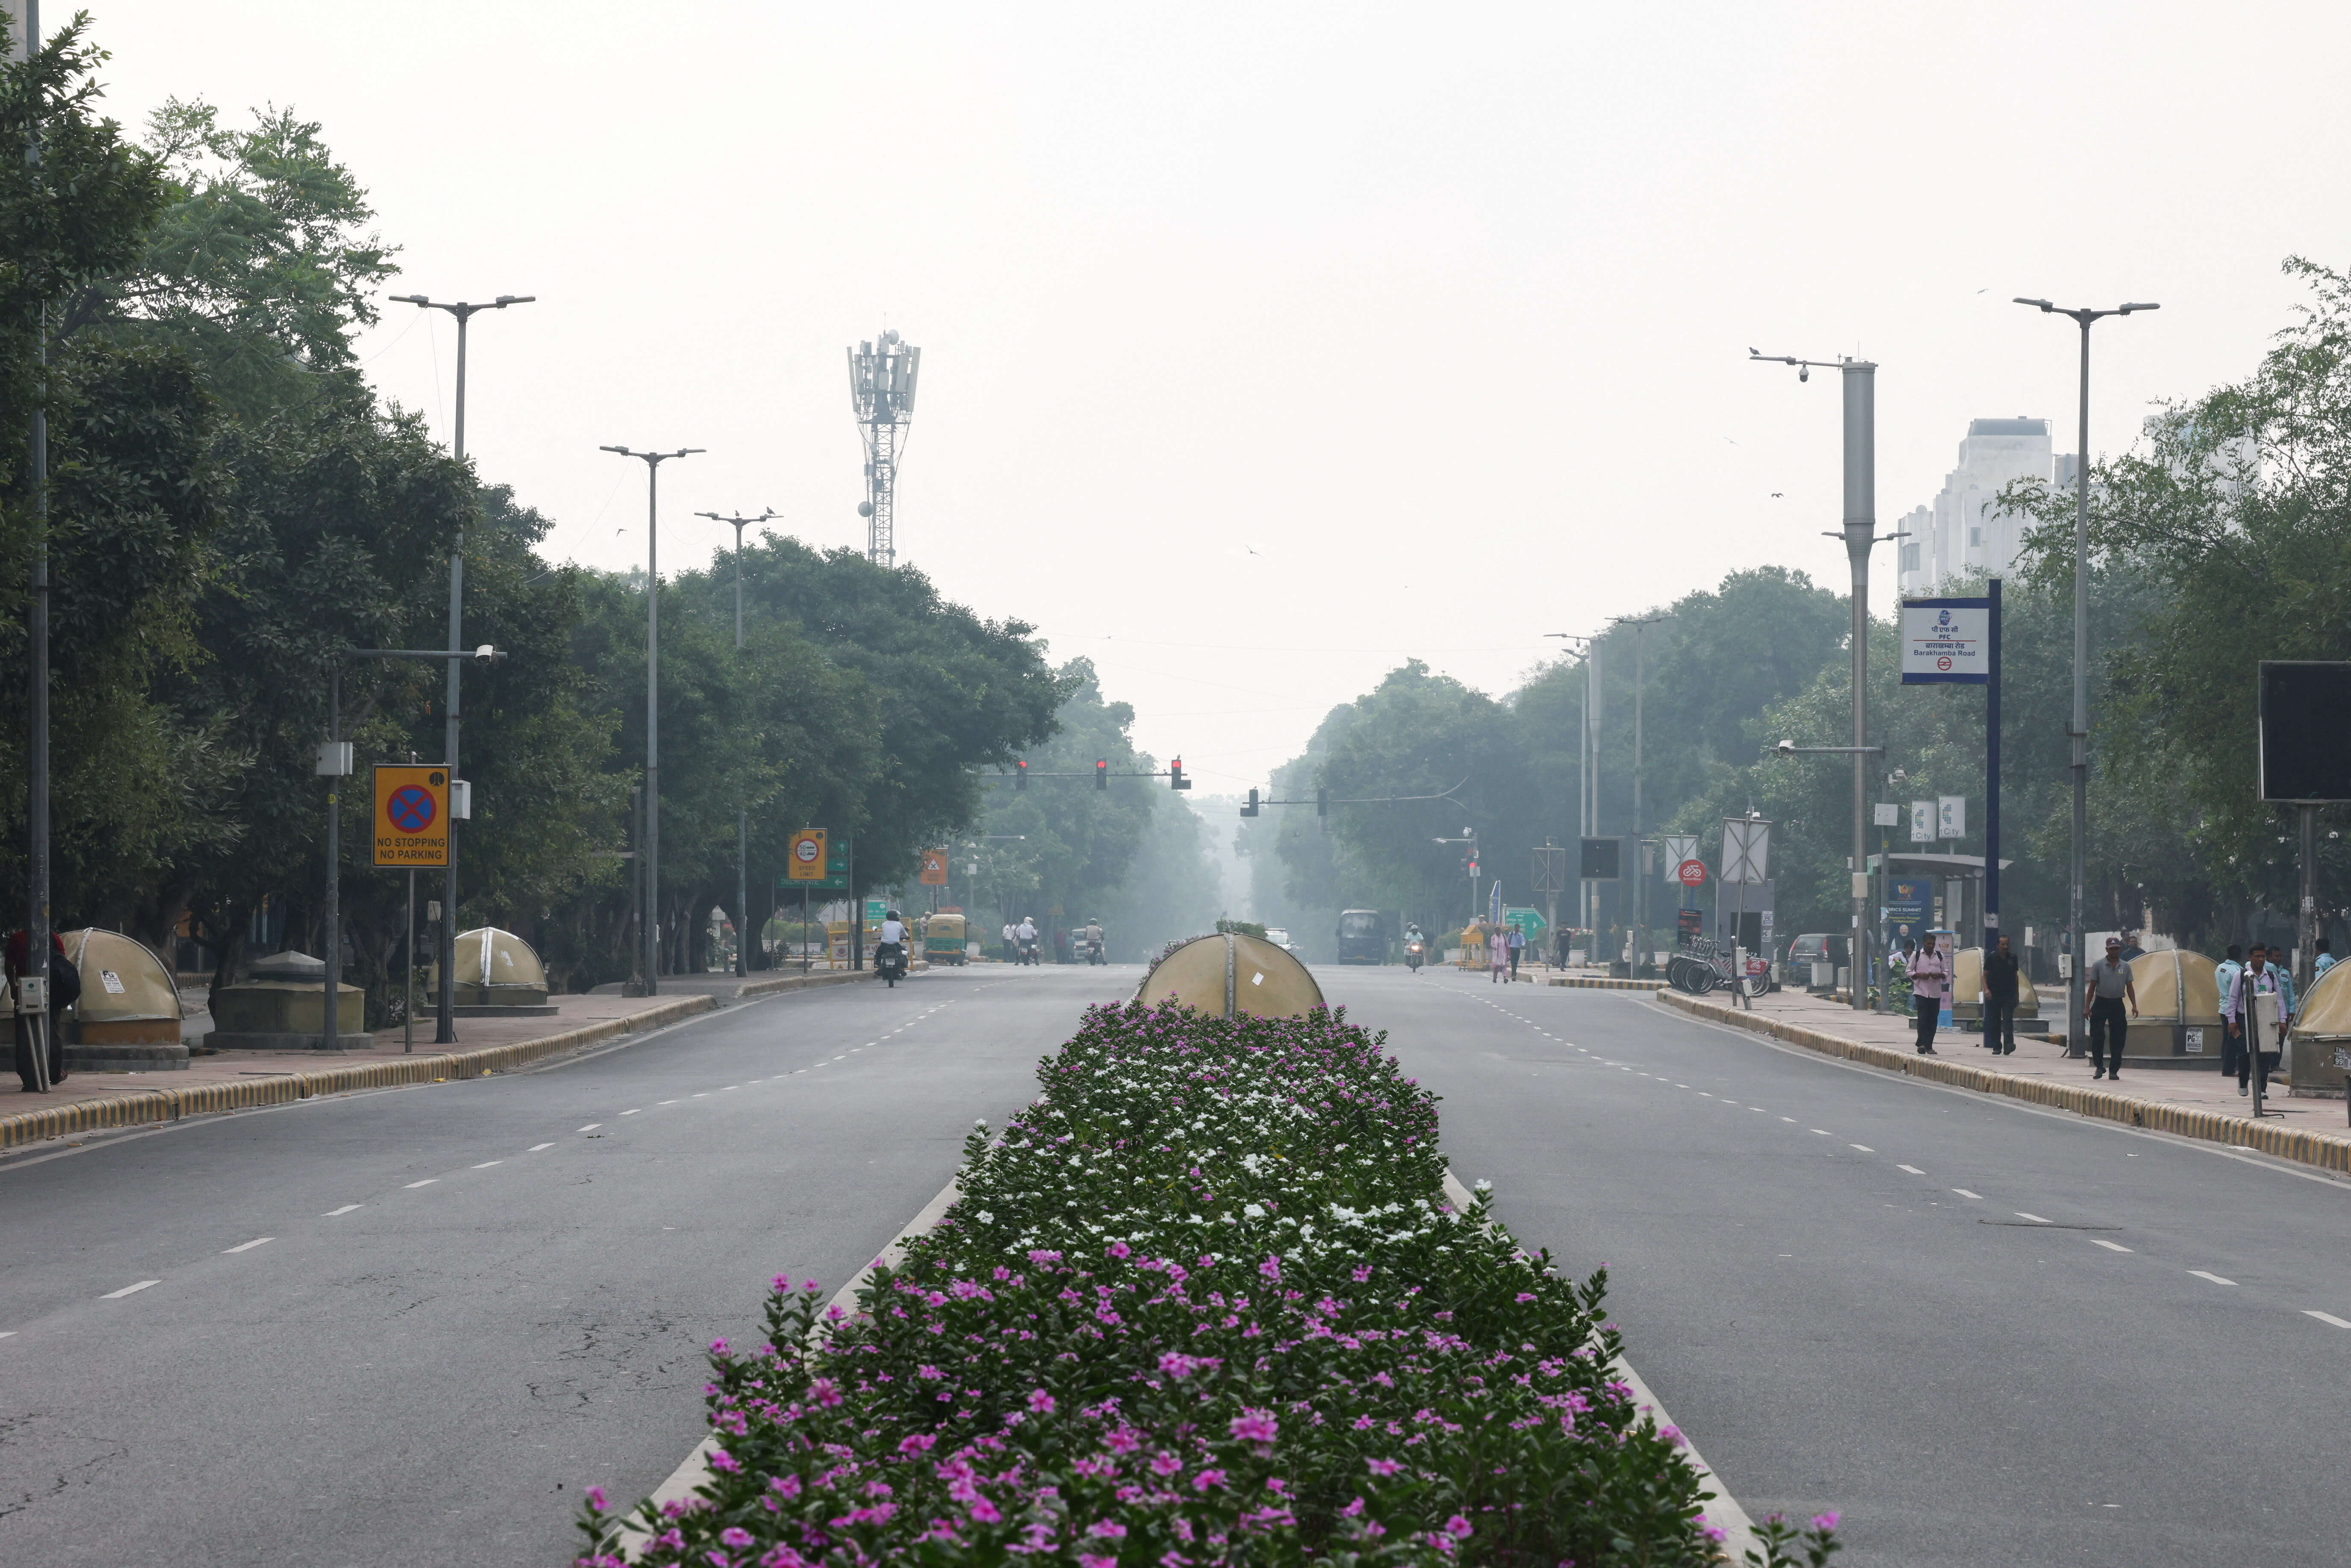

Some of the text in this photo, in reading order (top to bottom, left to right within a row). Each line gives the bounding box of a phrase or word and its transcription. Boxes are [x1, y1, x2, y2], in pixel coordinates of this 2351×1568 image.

[377, 838, 445, 847] NO STOPPING
[380, 850, 442, 859] NO PARKING
